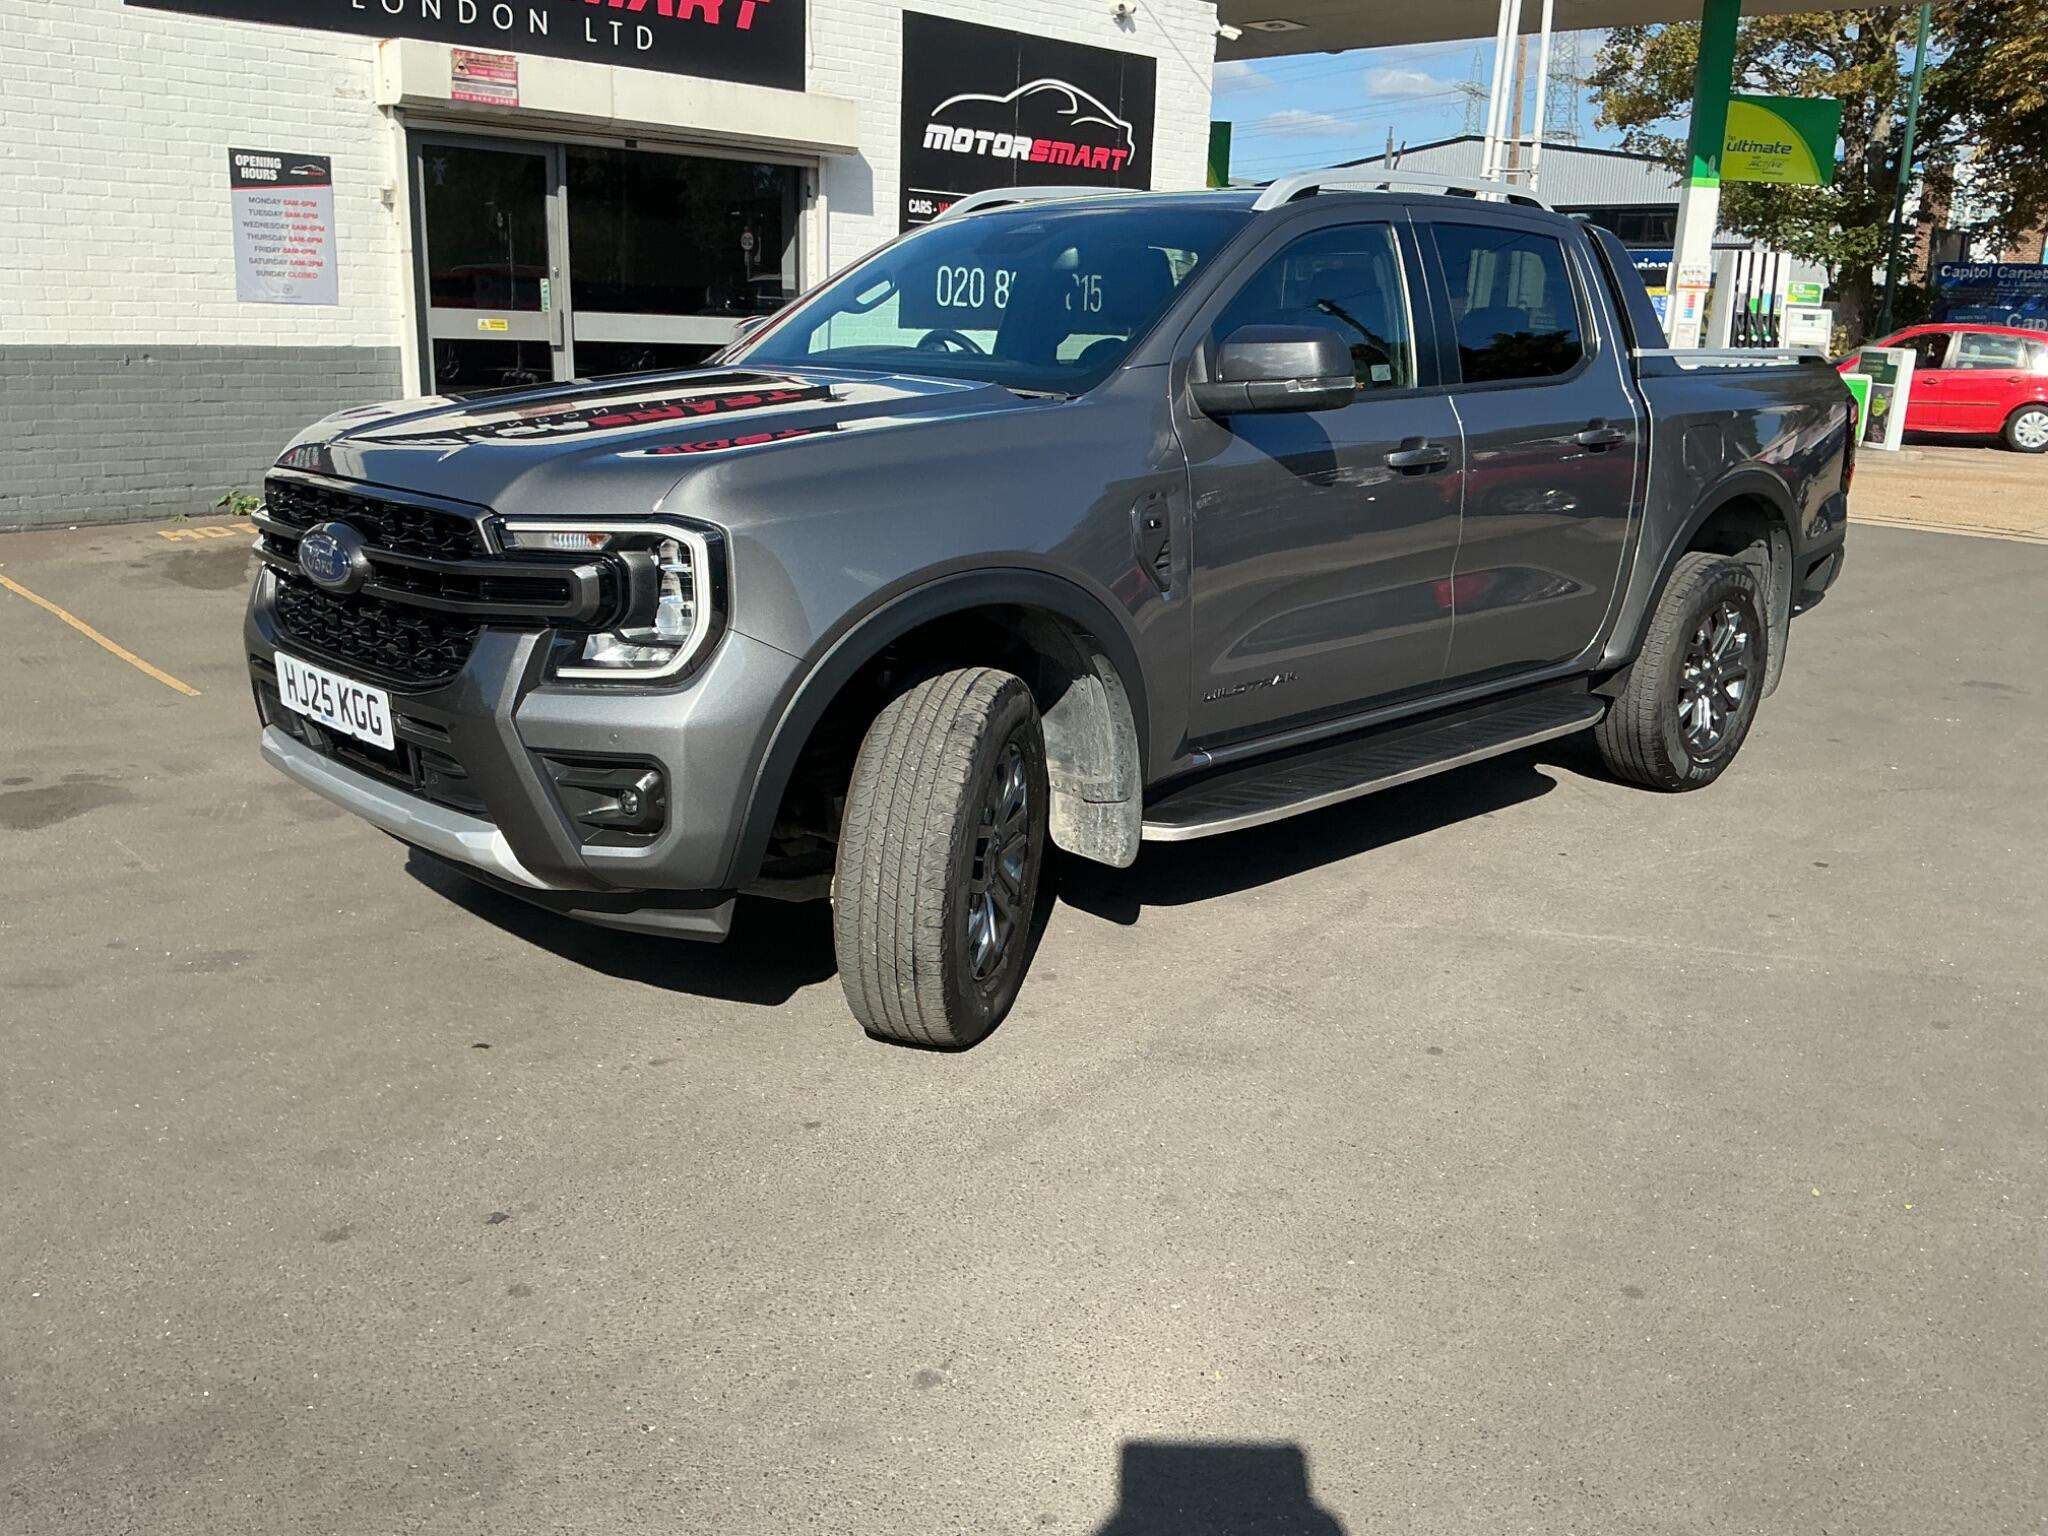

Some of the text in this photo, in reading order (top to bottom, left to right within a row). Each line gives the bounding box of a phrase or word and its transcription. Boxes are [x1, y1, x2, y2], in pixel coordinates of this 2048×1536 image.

[585, 17, 653, 50] LTD
[922, 123, 1128, 171] MOTORSMART
[1727, 139, 1792, 155] ultimate
[235, 154, 282, 170] OPENING
[241, 167, 278, 181] HOURS
[908, 198, 933, 215] CARS
[1941, 265, 1993, 280] Capitol
[936, 265, 985, 308] 020
[284, 661, 383, 737] HJ25 KGG
